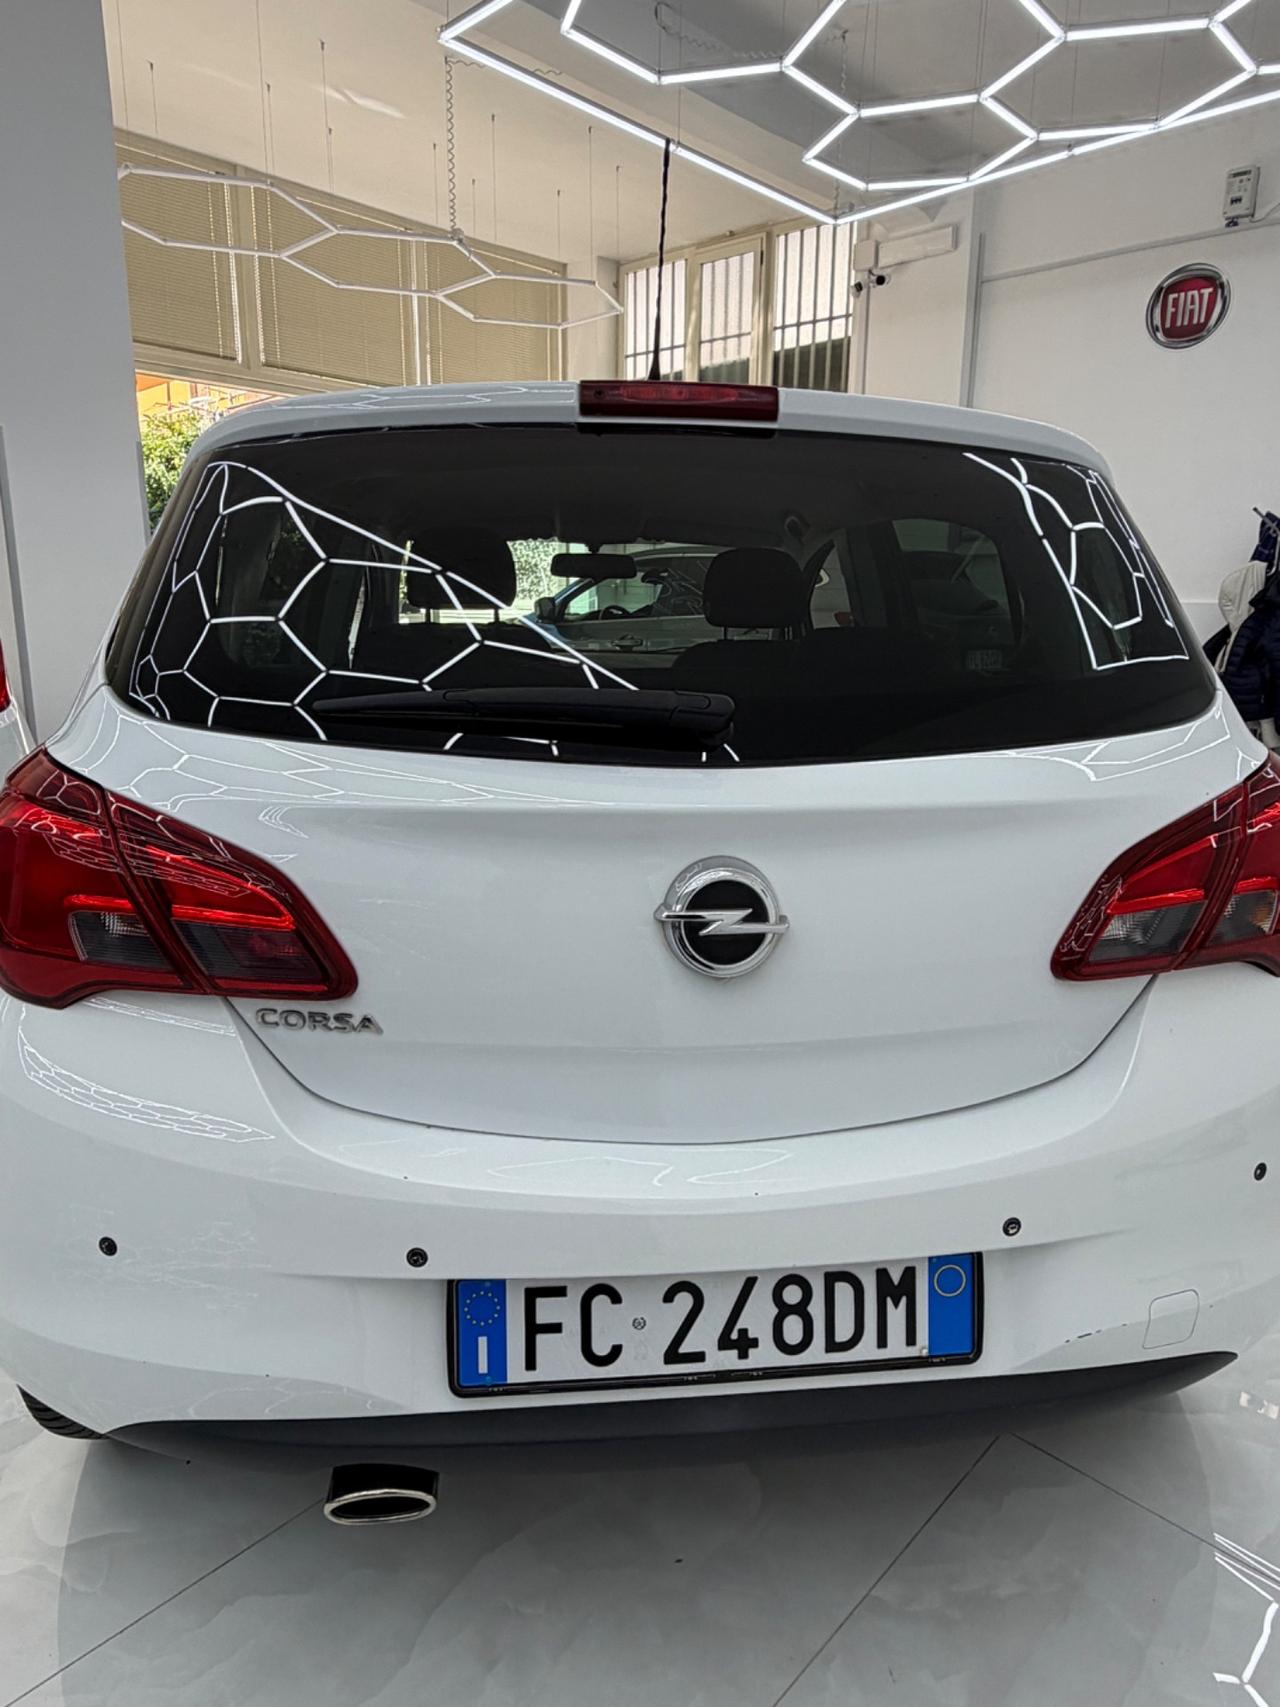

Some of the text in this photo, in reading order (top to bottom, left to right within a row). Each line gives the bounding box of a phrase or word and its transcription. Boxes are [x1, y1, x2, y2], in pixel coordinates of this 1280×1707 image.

[1164, 287, 1214, 329] FIAT
[255, 1007, 384, 1035] CORSA
[523, 1265, 918, 1372] FC 248DM
[477, 1335, 489, 1374] I
